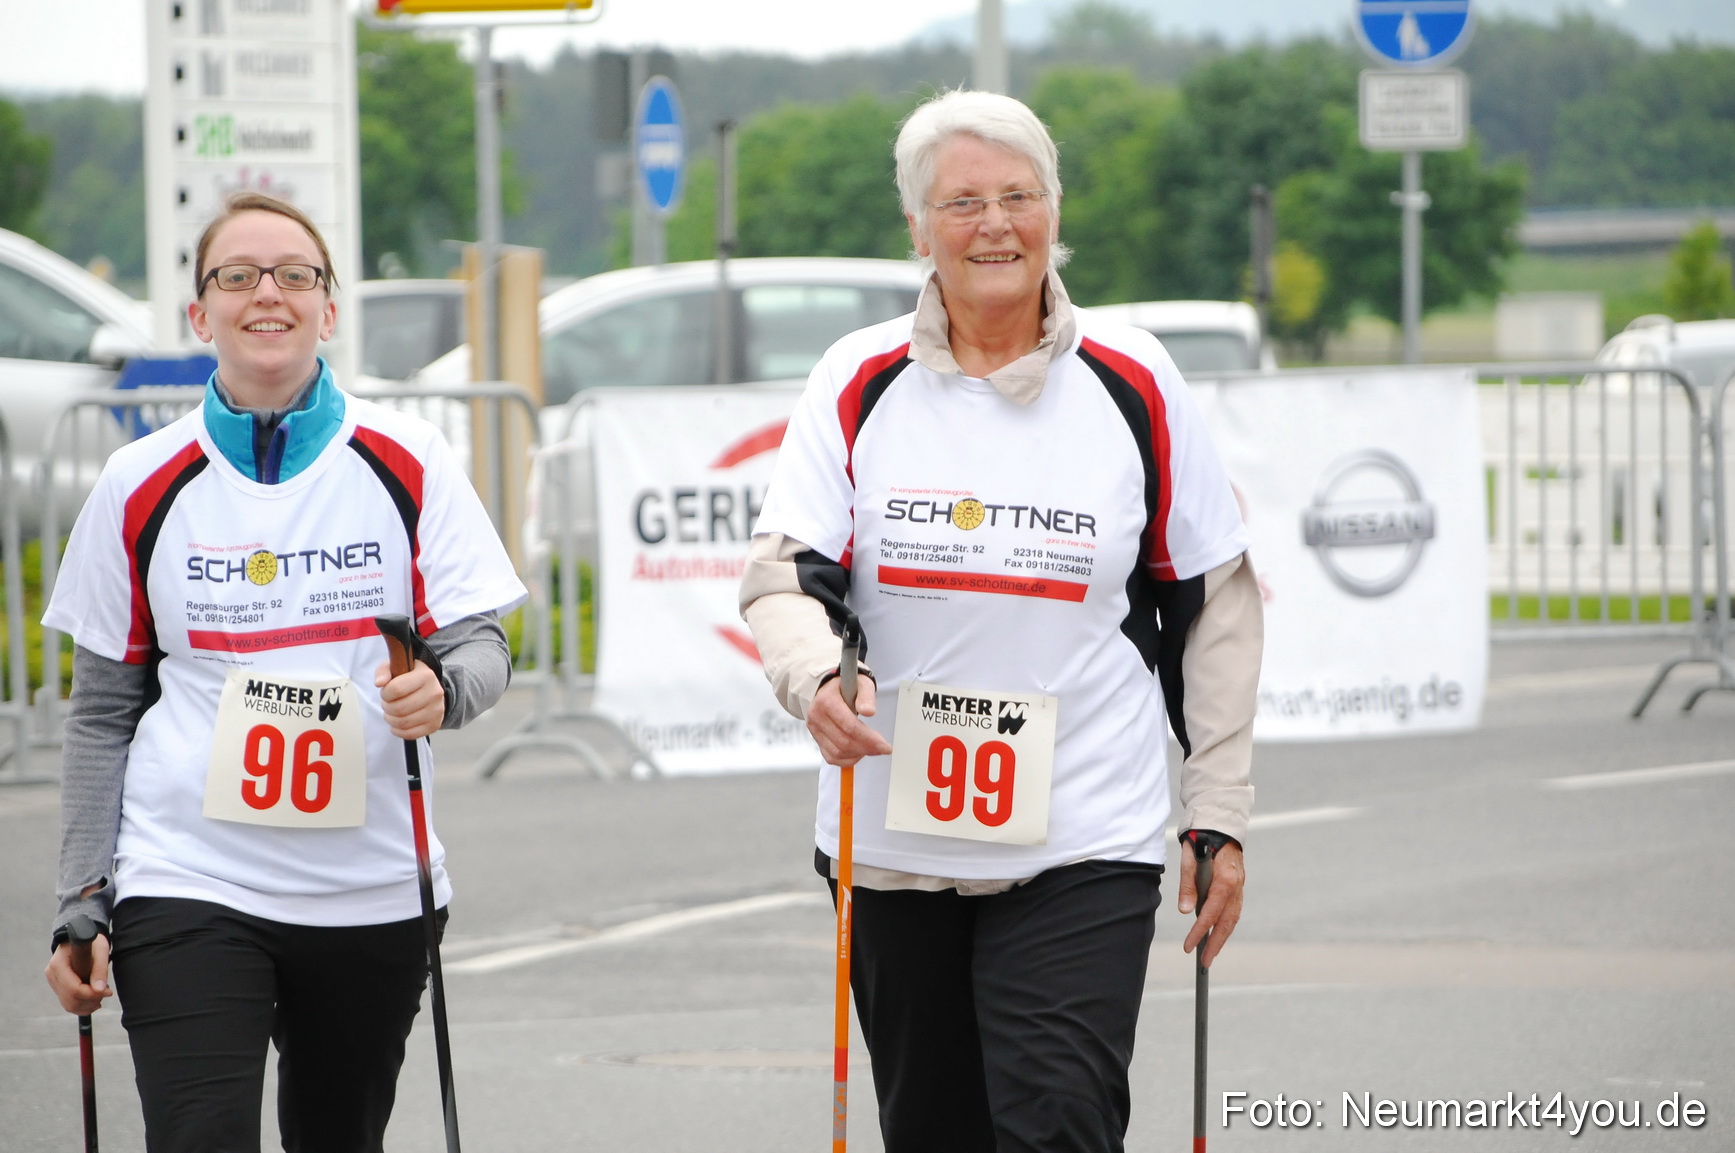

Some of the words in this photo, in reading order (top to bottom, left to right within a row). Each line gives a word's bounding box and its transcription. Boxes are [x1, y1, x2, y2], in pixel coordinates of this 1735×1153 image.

[1313, 510, 1422, 538] NISSAN
[881, 538, 949, 553] Regensburger
[952, 543, 969, 554] Str.
[972, 545, 985, 554] 92
[880, 549, 894, 560] Tel.
[897, 551, 964, 564] 09181/254801
[1013, 547, 1043, 559] 92318
[1046, 550, 1094, 566] Neumarkt
[1004, 558, 1022, 569] Fax
[1026, 560, 1092, 577] 09181/254803
[915, 574, 1046, 594] www.sv-schottner.de
[309, 591, 338, 603] 92318
[341, 586, 384, 599] Neumarkt
[186, 600, 249, 613] Regensburger
[252, 601, 268, 610] Str.
[271, 599, 283, 609] 92
[303, 605, 321, 616] Fax
[323, 598, 385, 614] 09181/254803
[187, 613, 203, 622] Tel.
[205, 613, 264, 625] 09181/254801
[226, 625, 350, 648] www.sv-schottner.de
[244, 678, 314, 705] MEYER
[244, 697, 313, 718] WERBUNG
[921, 691, 993, 717] MEYER
[921, 708, 992, 730] WERBUNG
[241, 723, 334, 813] 96
[925, 735, 1016, 827] 99
